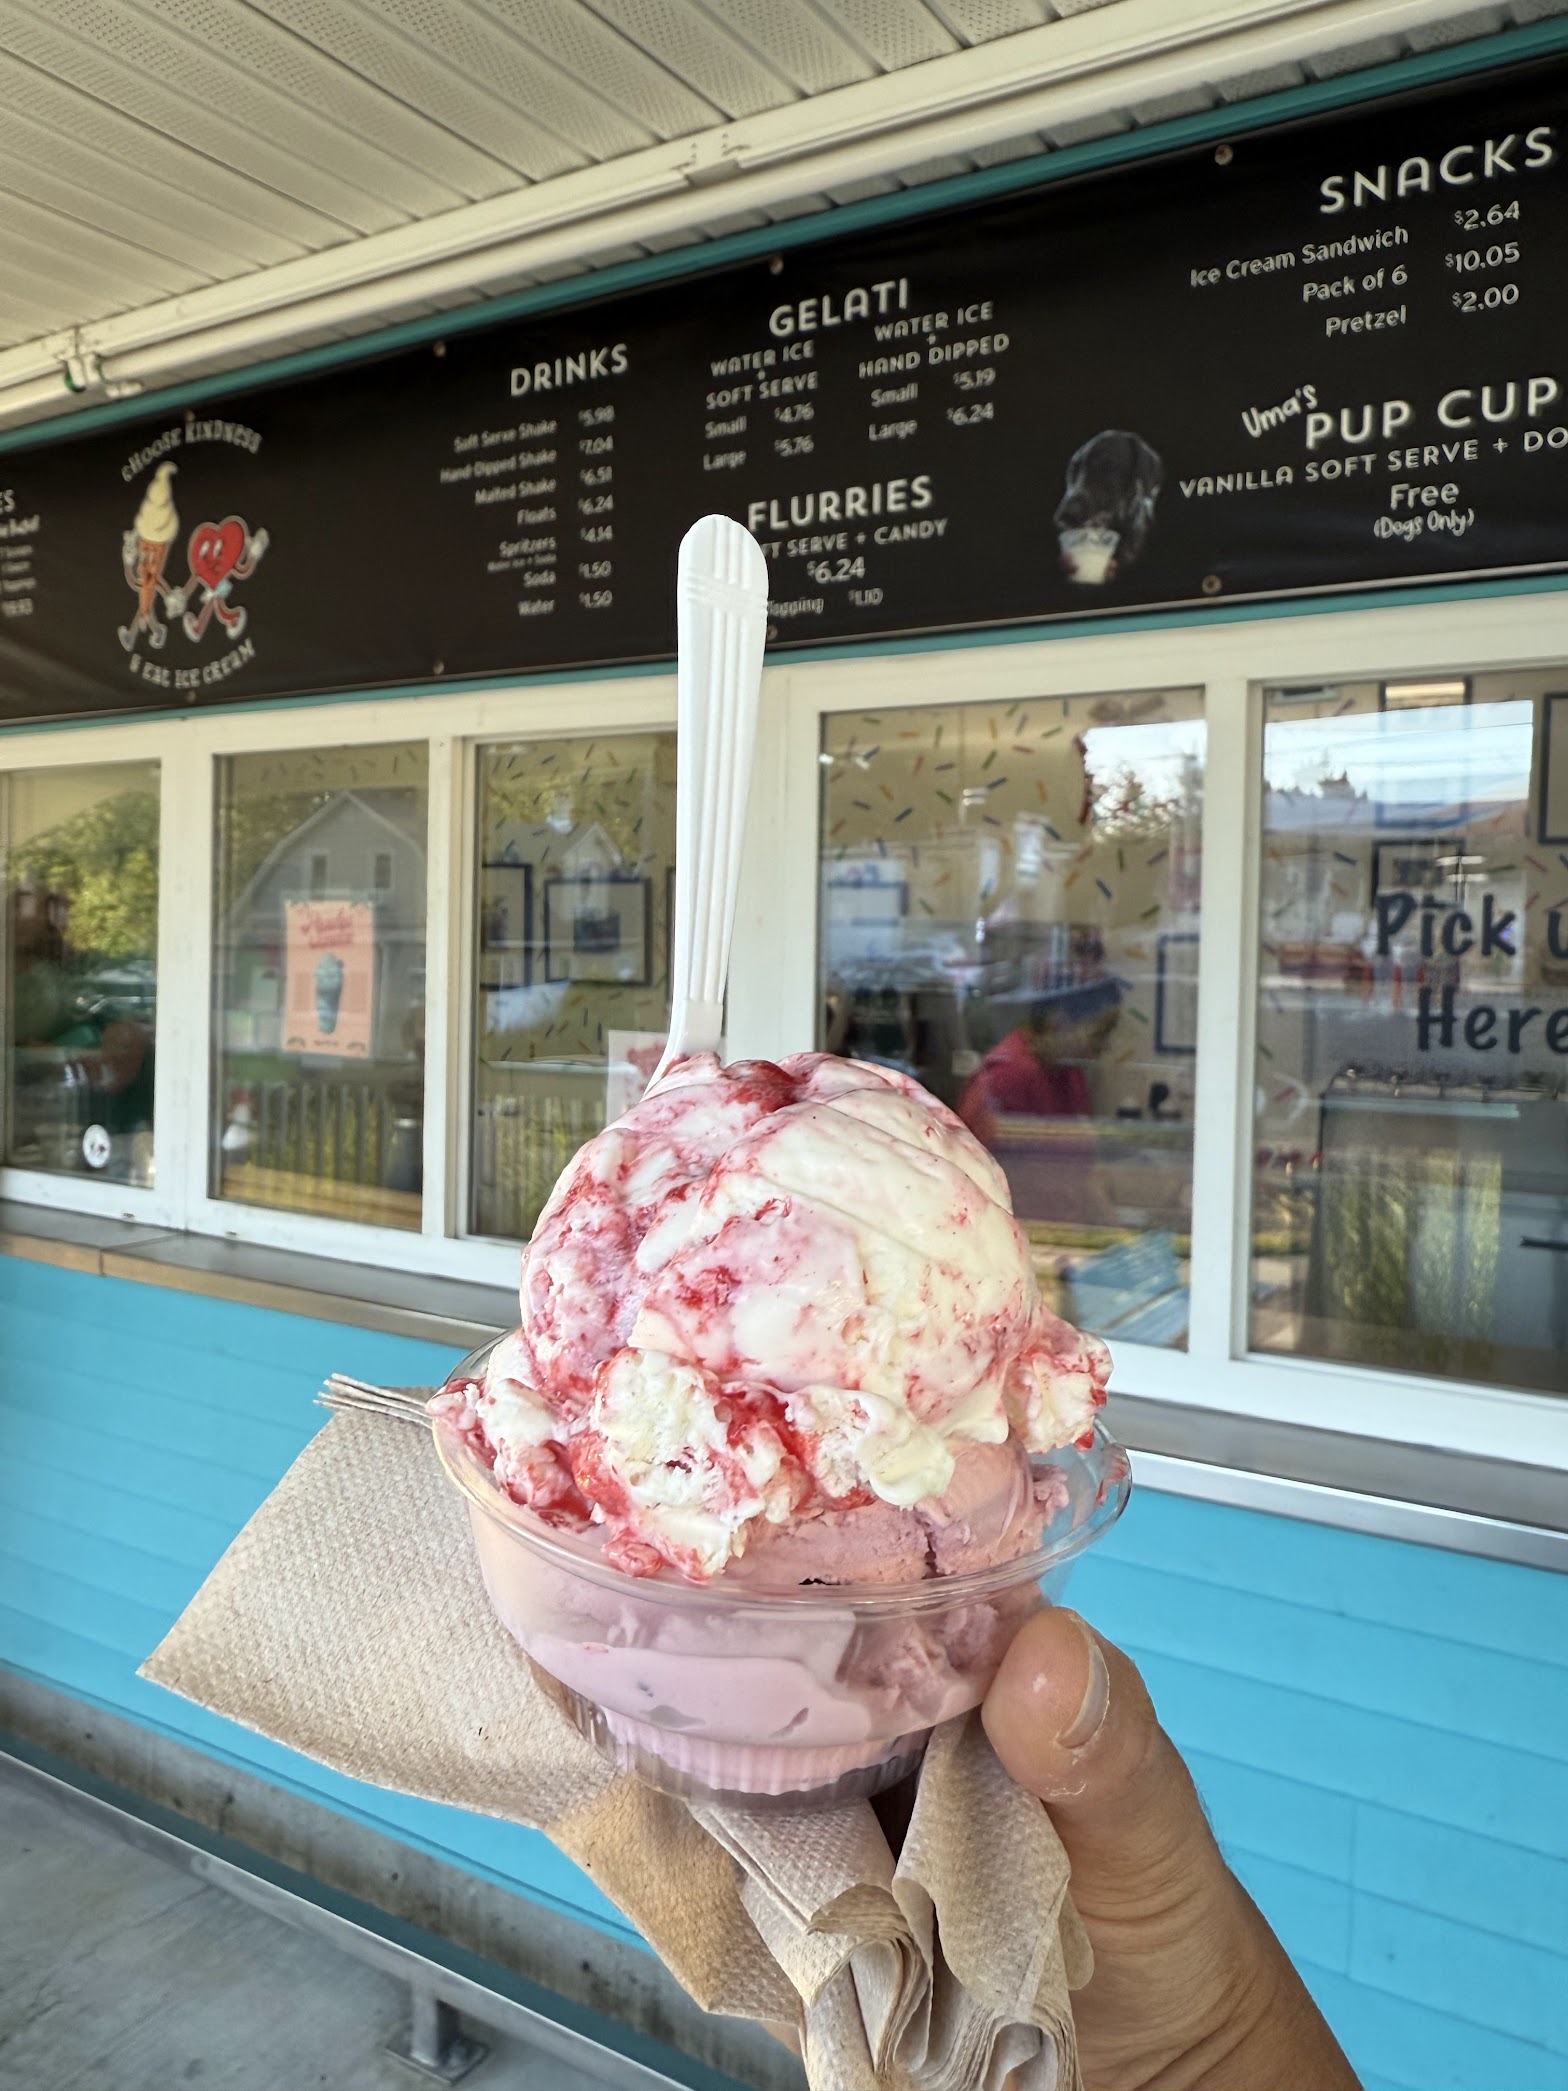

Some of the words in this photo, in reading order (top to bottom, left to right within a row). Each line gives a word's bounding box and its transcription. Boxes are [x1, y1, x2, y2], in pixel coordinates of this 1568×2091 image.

[1319, 126, 1556, 214] SNACKS
[1190, 268, 1221, 287] Ice
[1226, 250, 1296, 281] Cream
[1302, 225, 1409, 265] Sandwich
[1454, 200, 1520, 232] $2.64
[1303, 276, 1356, 303] Pack
[1362, 268, 1385, 292] of
[1392, 264, 1409, 286] 6
[1445, 241, 1521, 274] $10.05
[769, 277, 909, 337] GELATI
[874, 311, 949, 342] WATER
[957, 301, 993, 325] ICE
[1325, 305, 1408, 338] Pretzel
[1452, 283, 1520, 314] $2.00
[510, 342, 629, 397] DRINKS
[711, 348, 777, 377] WATER
[782, 339, 816, 362] ICE
[859, 350, 921, 379] HAND
[928, 333, 1010, 365] DIPPED
[706, 384, 754, 410] SOFT
[759, 371, 819, 399] SERVE
[871, 382, 919, 408] Small
[1242, 384, 1318, 439] Uma's
[1305, 400, 1412, 450] PUP
[1437, 376, 1558, 429] CUP
[705, 415, 748, 439] Small
[868, 419, 918, 441] Large
[946, 402, 995, 426] $6.24
[703, 450, 747, 471] Large
[1179, 465, 1294, 499] VANILLA
[1305, 453, 1378, 483] SOFT
[1387, 438, 1479, 472] SERVE
[748, 475, 933, 532] FLURRIES
[1390, 481, 1460, 510] Free
[786, 531, 849, 558] SERVE
[873, 517, 949, 545] CANDY
[1374, 515, 1424, 542] (Dogs
[1428, 508, 1475, 537] Only)
[807, 556, 866, 584] $6.24
[1375, 891, 1516, 956] Pick
[1416, 986, 1568, 1054] Here
